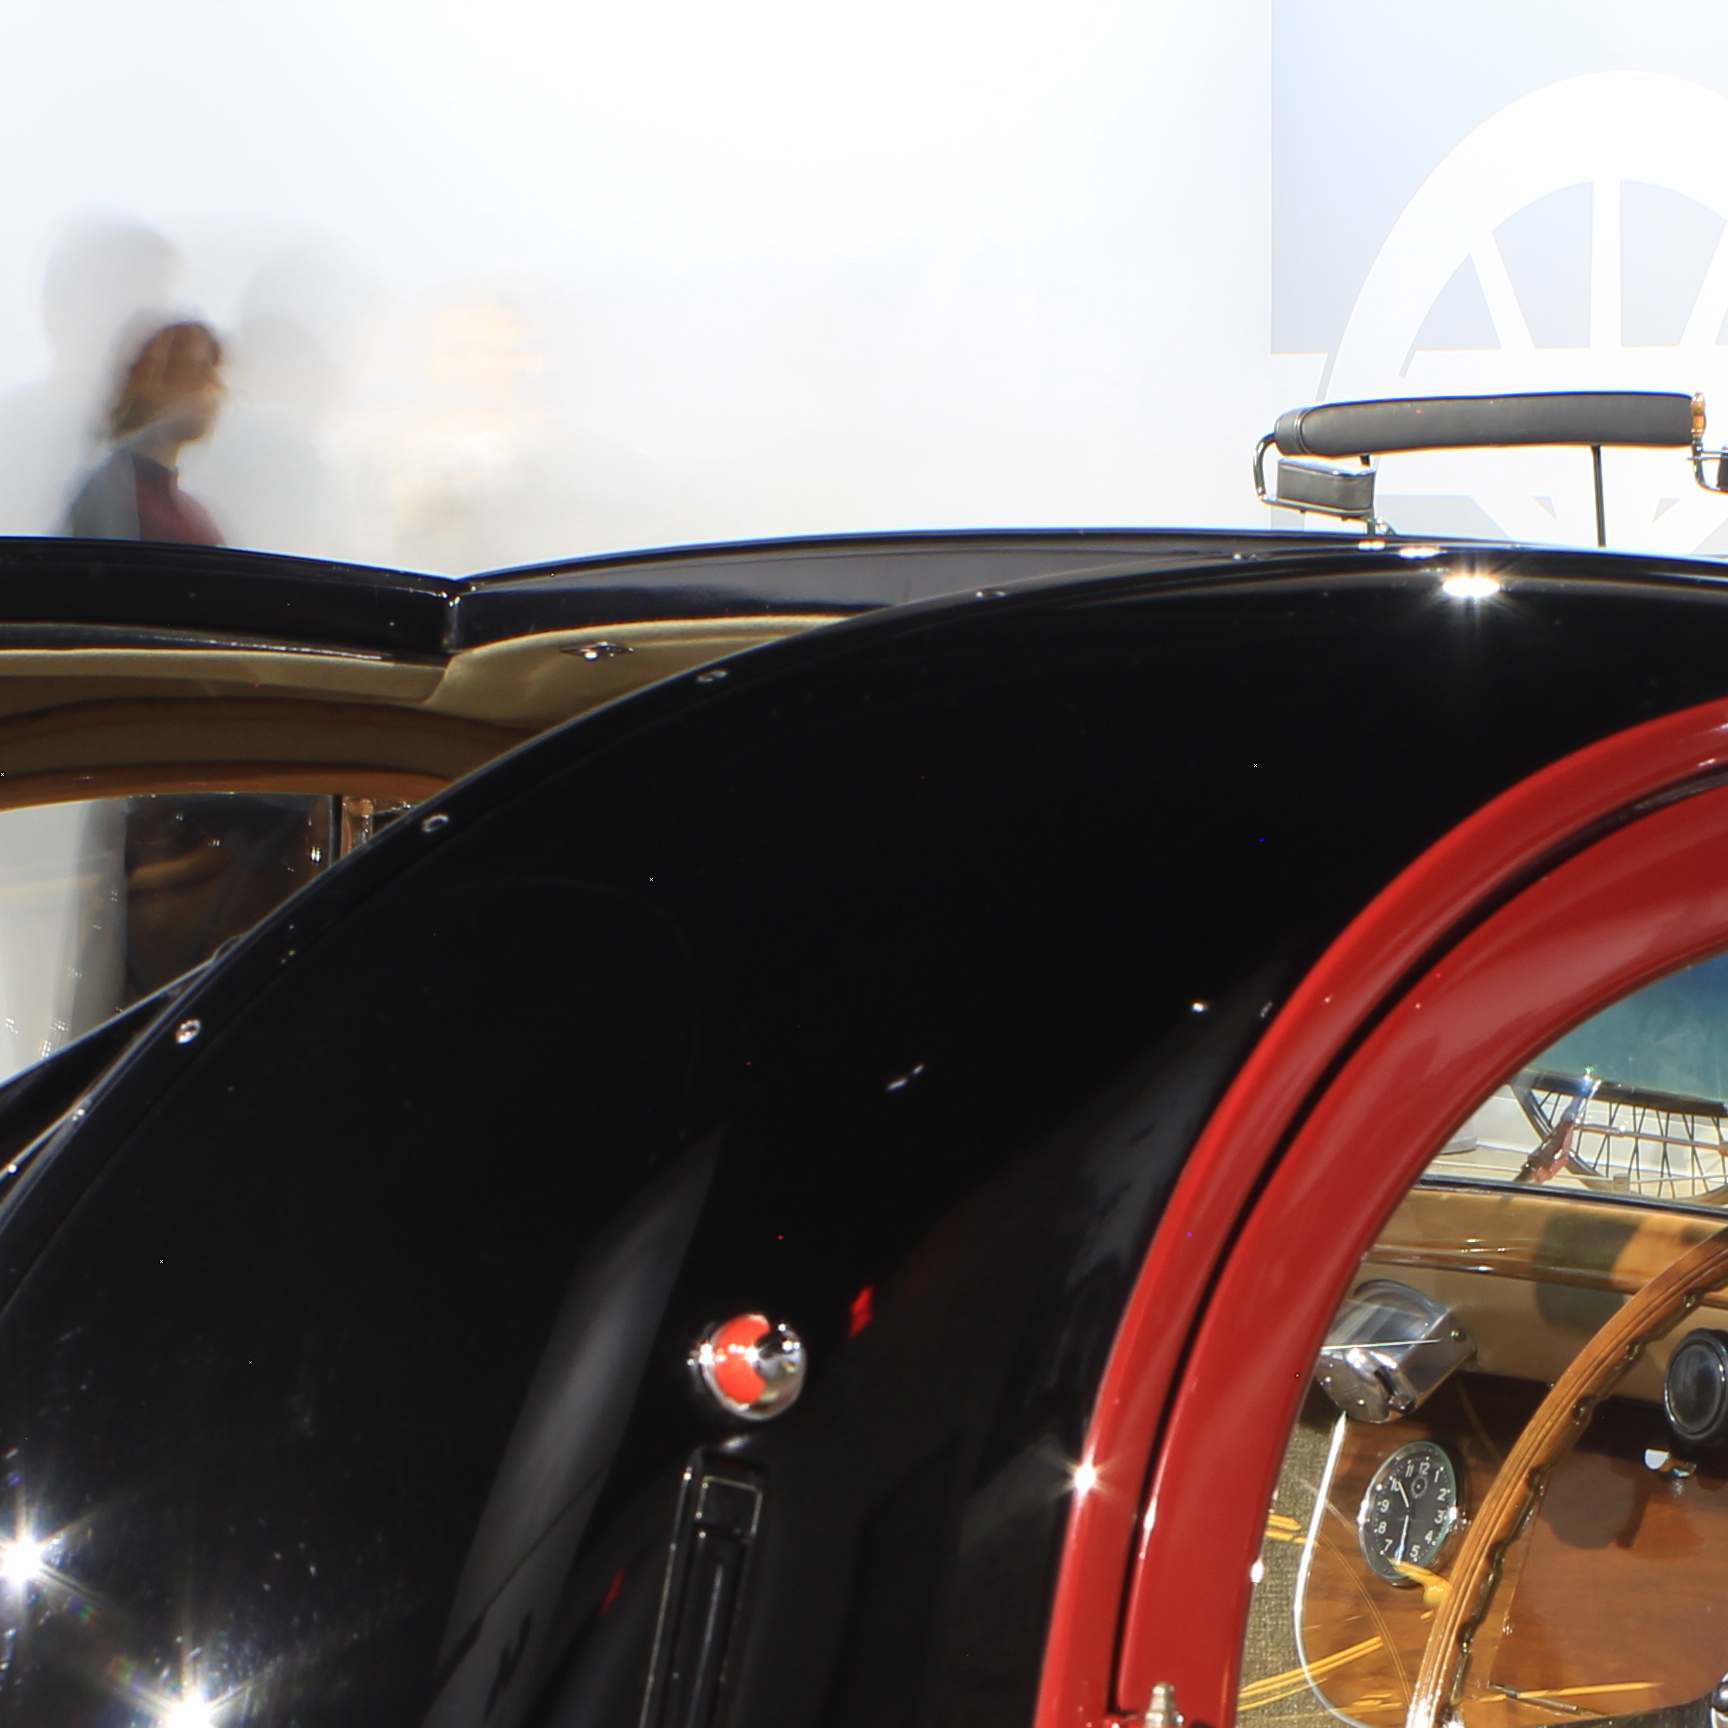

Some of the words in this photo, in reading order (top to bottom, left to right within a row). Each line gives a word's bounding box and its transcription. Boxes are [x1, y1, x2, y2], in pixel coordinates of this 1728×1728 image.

[1405, 1464, 1415, 1478] 11
[1419, 1461, 1430, 1475] 12
[1434, 1470, 1440, 1483] 1
[1437, 1488, 1447, 1501] 2
[1380, 1499, 1390, 1513] 9
[1434, 1510, 1445, 1524] 3
[1378, 1521, 1387, 1534] 8
[1425, 1530, 1434, 1544] 4
[1384, 1539, 1393, 1552] 7
[1410, 1545, 1420, 1558] 5
